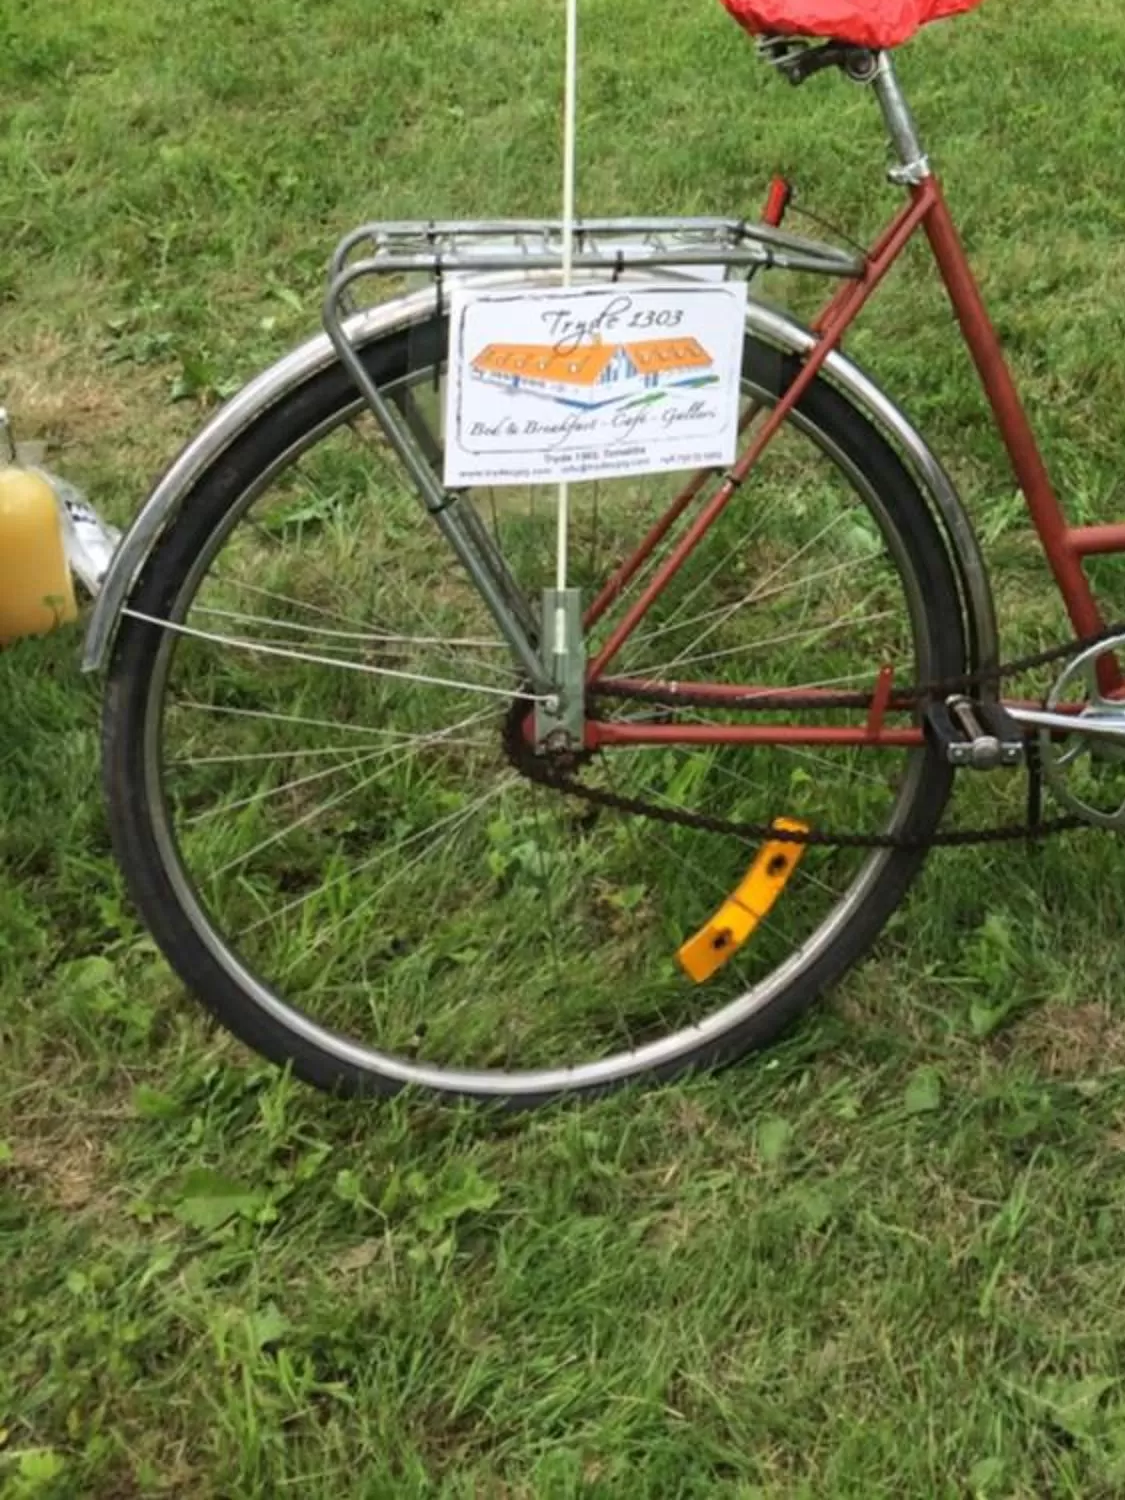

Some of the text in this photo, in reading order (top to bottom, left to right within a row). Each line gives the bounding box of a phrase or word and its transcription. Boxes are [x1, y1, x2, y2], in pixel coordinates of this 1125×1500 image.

[541, 296, 684, 356] Tryde 1303
[469, 416, 511, 437] Bed
[523, 412, 597, 449] Breakfast
